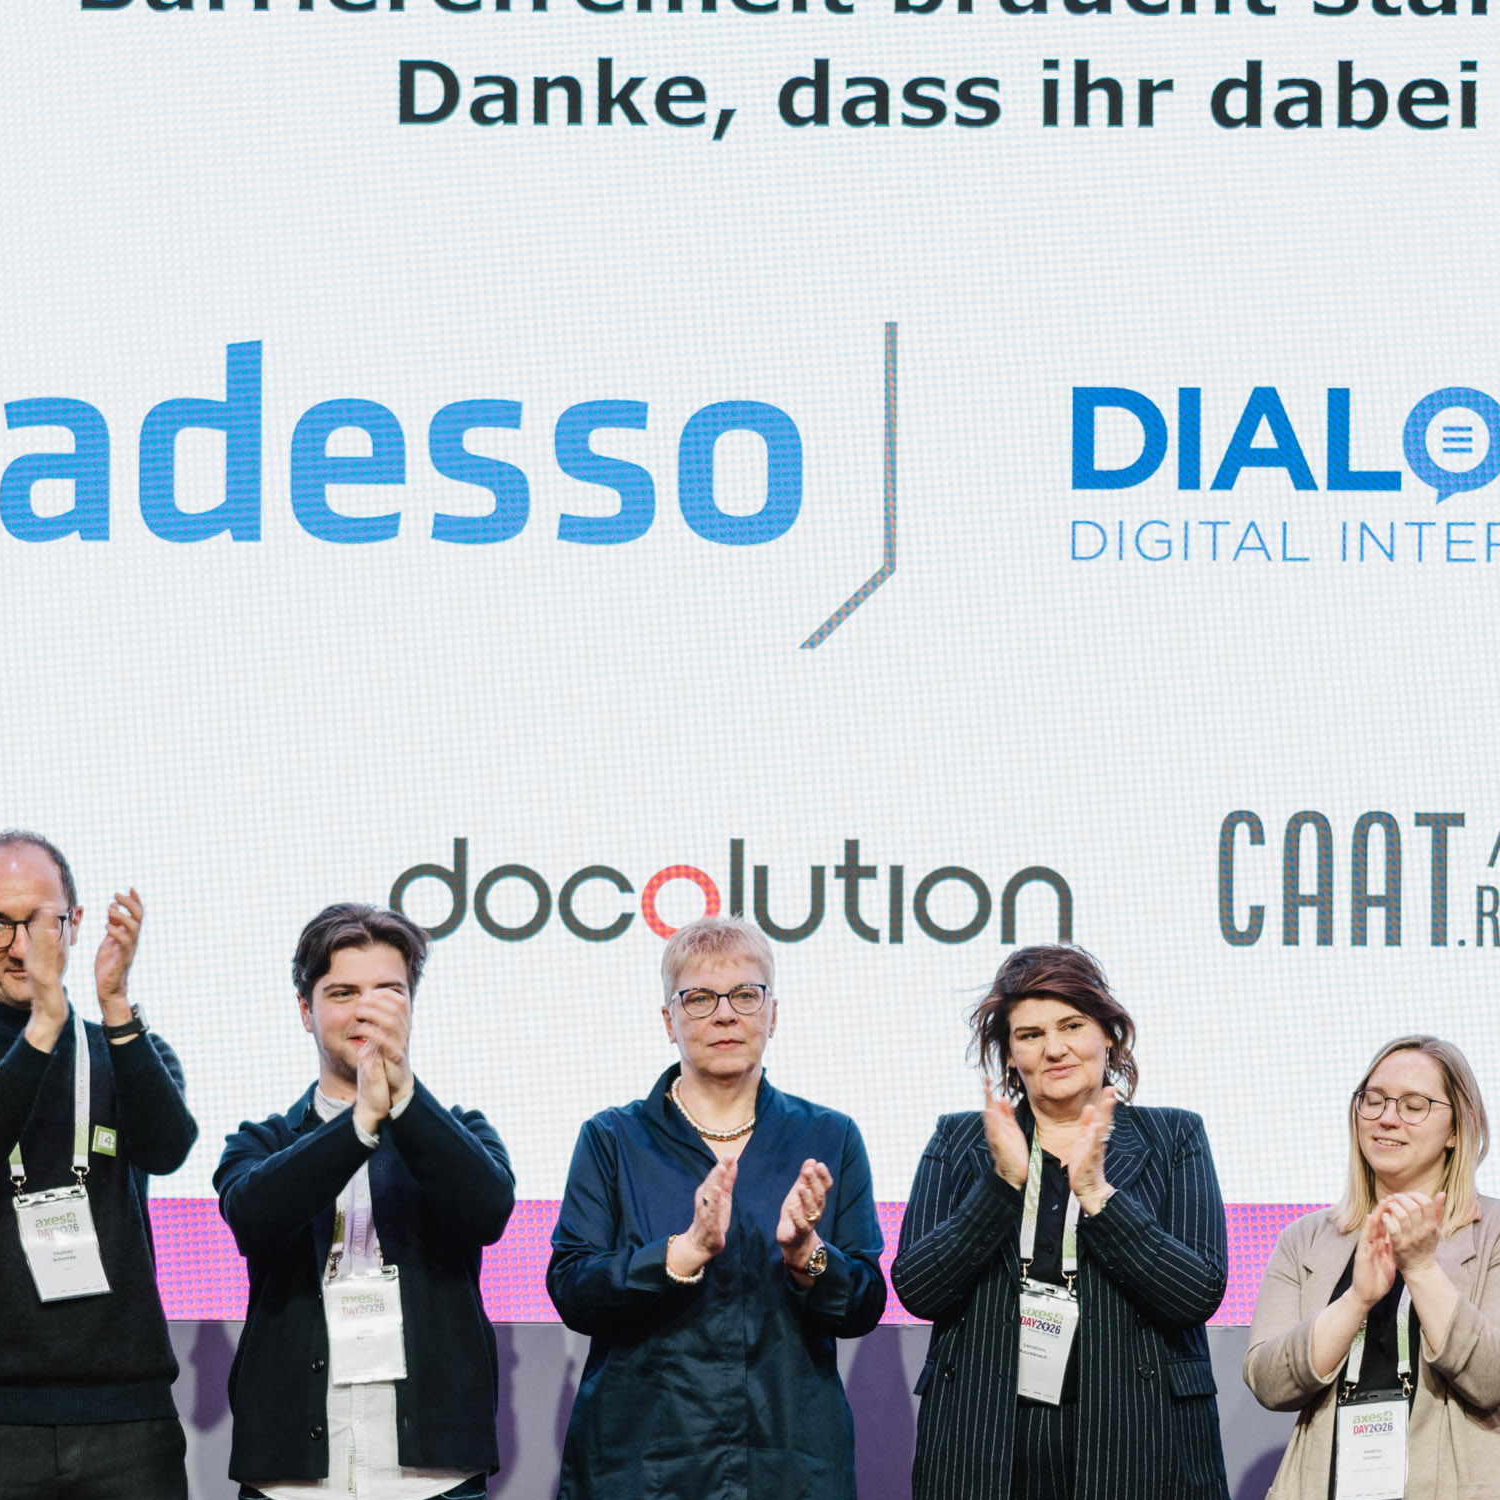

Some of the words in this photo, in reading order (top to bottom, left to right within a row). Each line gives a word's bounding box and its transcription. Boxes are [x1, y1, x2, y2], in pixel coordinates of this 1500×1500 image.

[399, 57, 736, 141] Danke,
[778, 58, 1001, 128] dass
[1043, 59, 1174, 127] ihr
[1210, 60, 1478, 130] dabei
[1071, 520, 1310, 562] DIGITAL
[389, 837, 1073, 944] docolution
